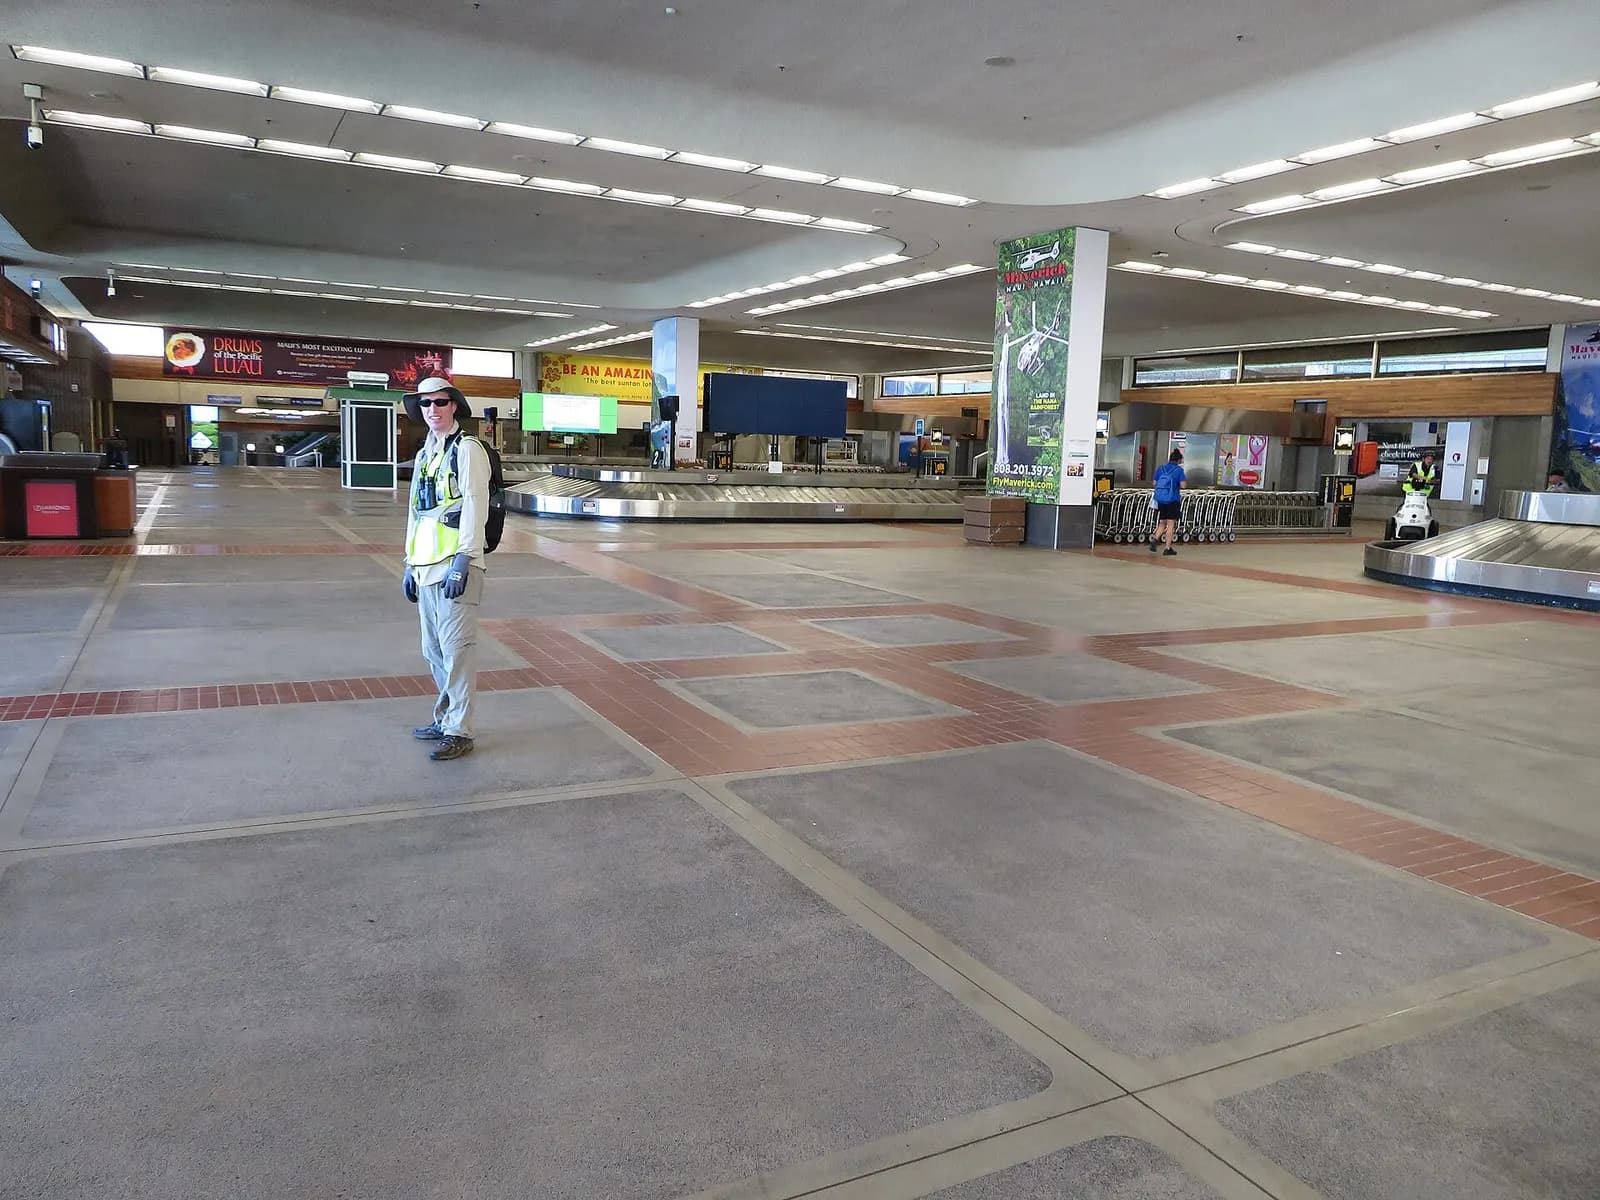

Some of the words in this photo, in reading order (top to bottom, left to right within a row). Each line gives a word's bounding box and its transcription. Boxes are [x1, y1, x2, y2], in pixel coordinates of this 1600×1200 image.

[1005, 263, 1066, 284] Maverick
[1006, 284, 1025, 292] MAUI
[1034, 277, 1063, 288] HAWAII
[213, 337, 263, 354] DRUMS
[302, 343, 321, 351] MOST
[322, 345, 353, 354] EXCITING
[213, 350, 223, 359] of
[223, 351, 237, 359] the
[237, 352, 263, 361] Pacific
[563, 364, 576, 375] BE
[581, 365, 600, 377] AN
[600, 378, 616, 386] best
[618, 379, 641, 388] suntan
[1382, 441, 1397, 449] Next
[1380, 450, 1400, 458] check
[1406, 450, 1421, 459] free
[994, 463, 1054, 476] 808.201.3972
[992, 477, 1053, 489] FlyMaverick.com
